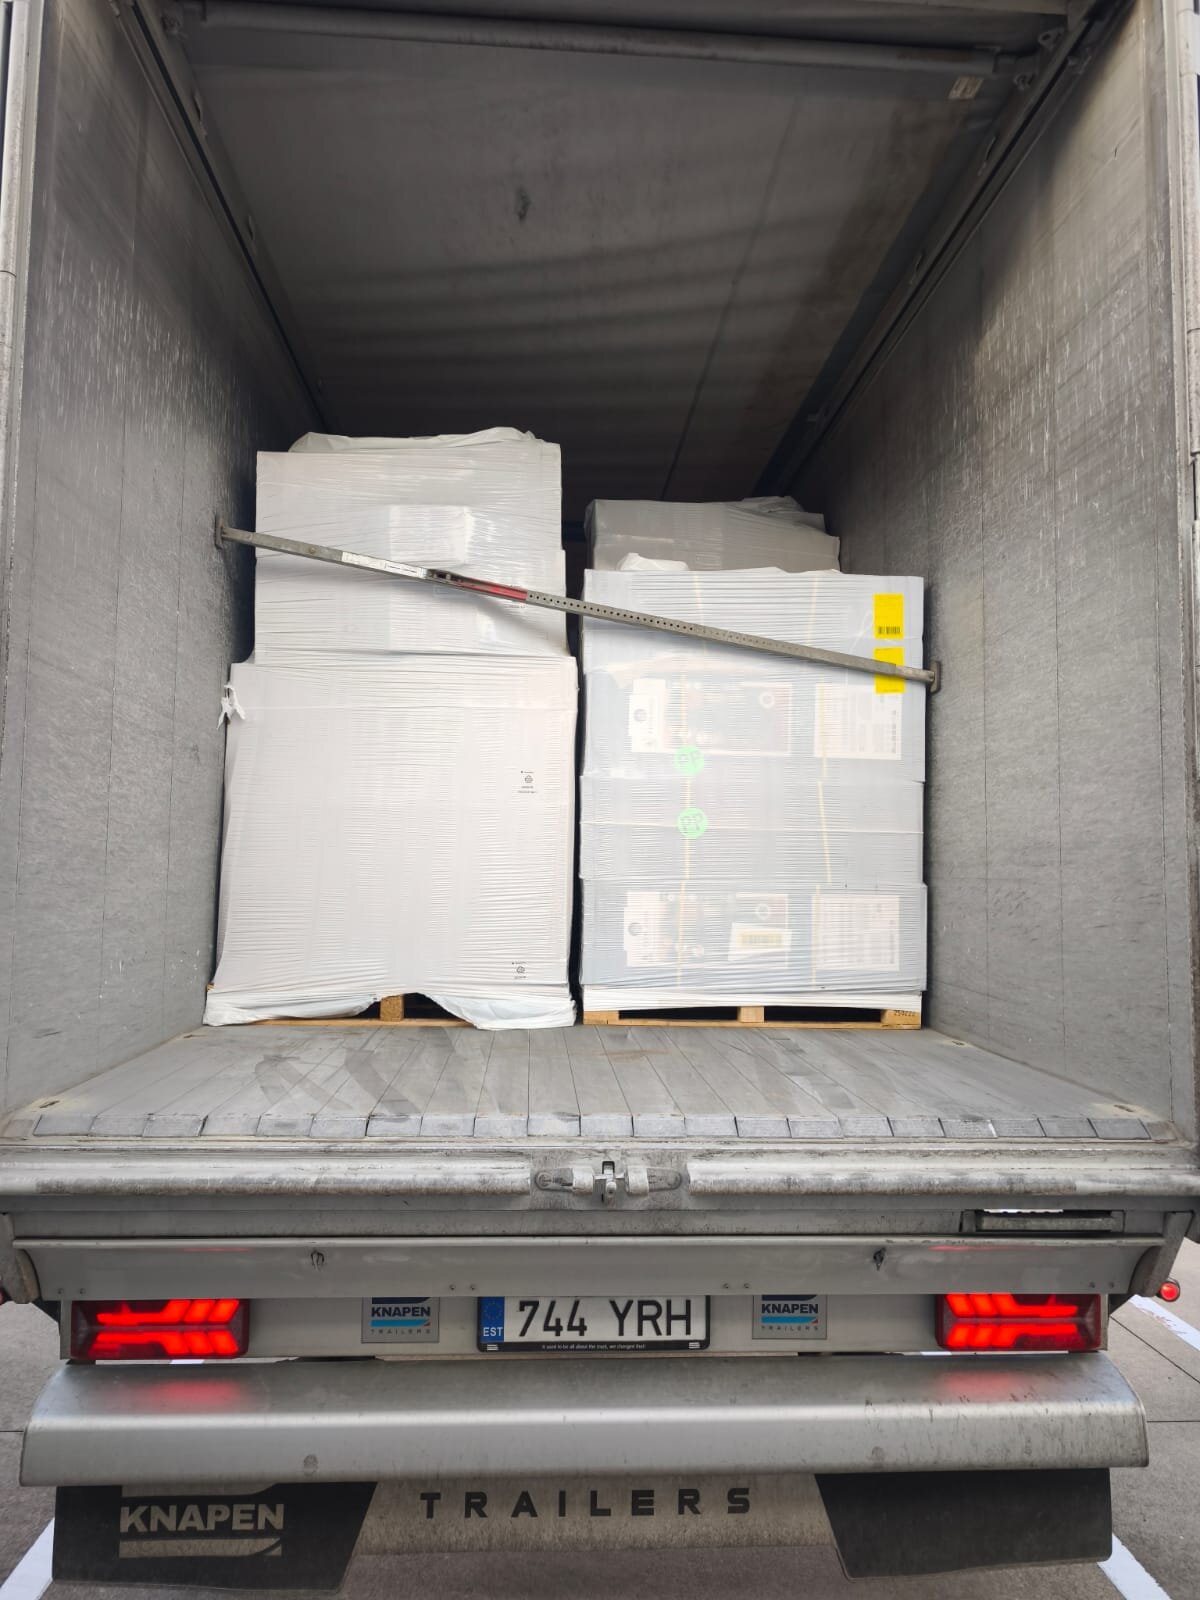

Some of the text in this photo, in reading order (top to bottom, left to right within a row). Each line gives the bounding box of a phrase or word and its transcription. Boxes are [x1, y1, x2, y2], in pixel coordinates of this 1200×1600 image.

[371, 1306, 431, 1317] KNAPEN
[518, 1299, 691, 1337] 744 YRH
[761, 1303, 819, 1314] KNAPEN
[483, 1326, 504, 1337] EST
[420, 1487, 751, 1519] TRAILERS
[119, 1503, 285, 1533] KNAPEN
